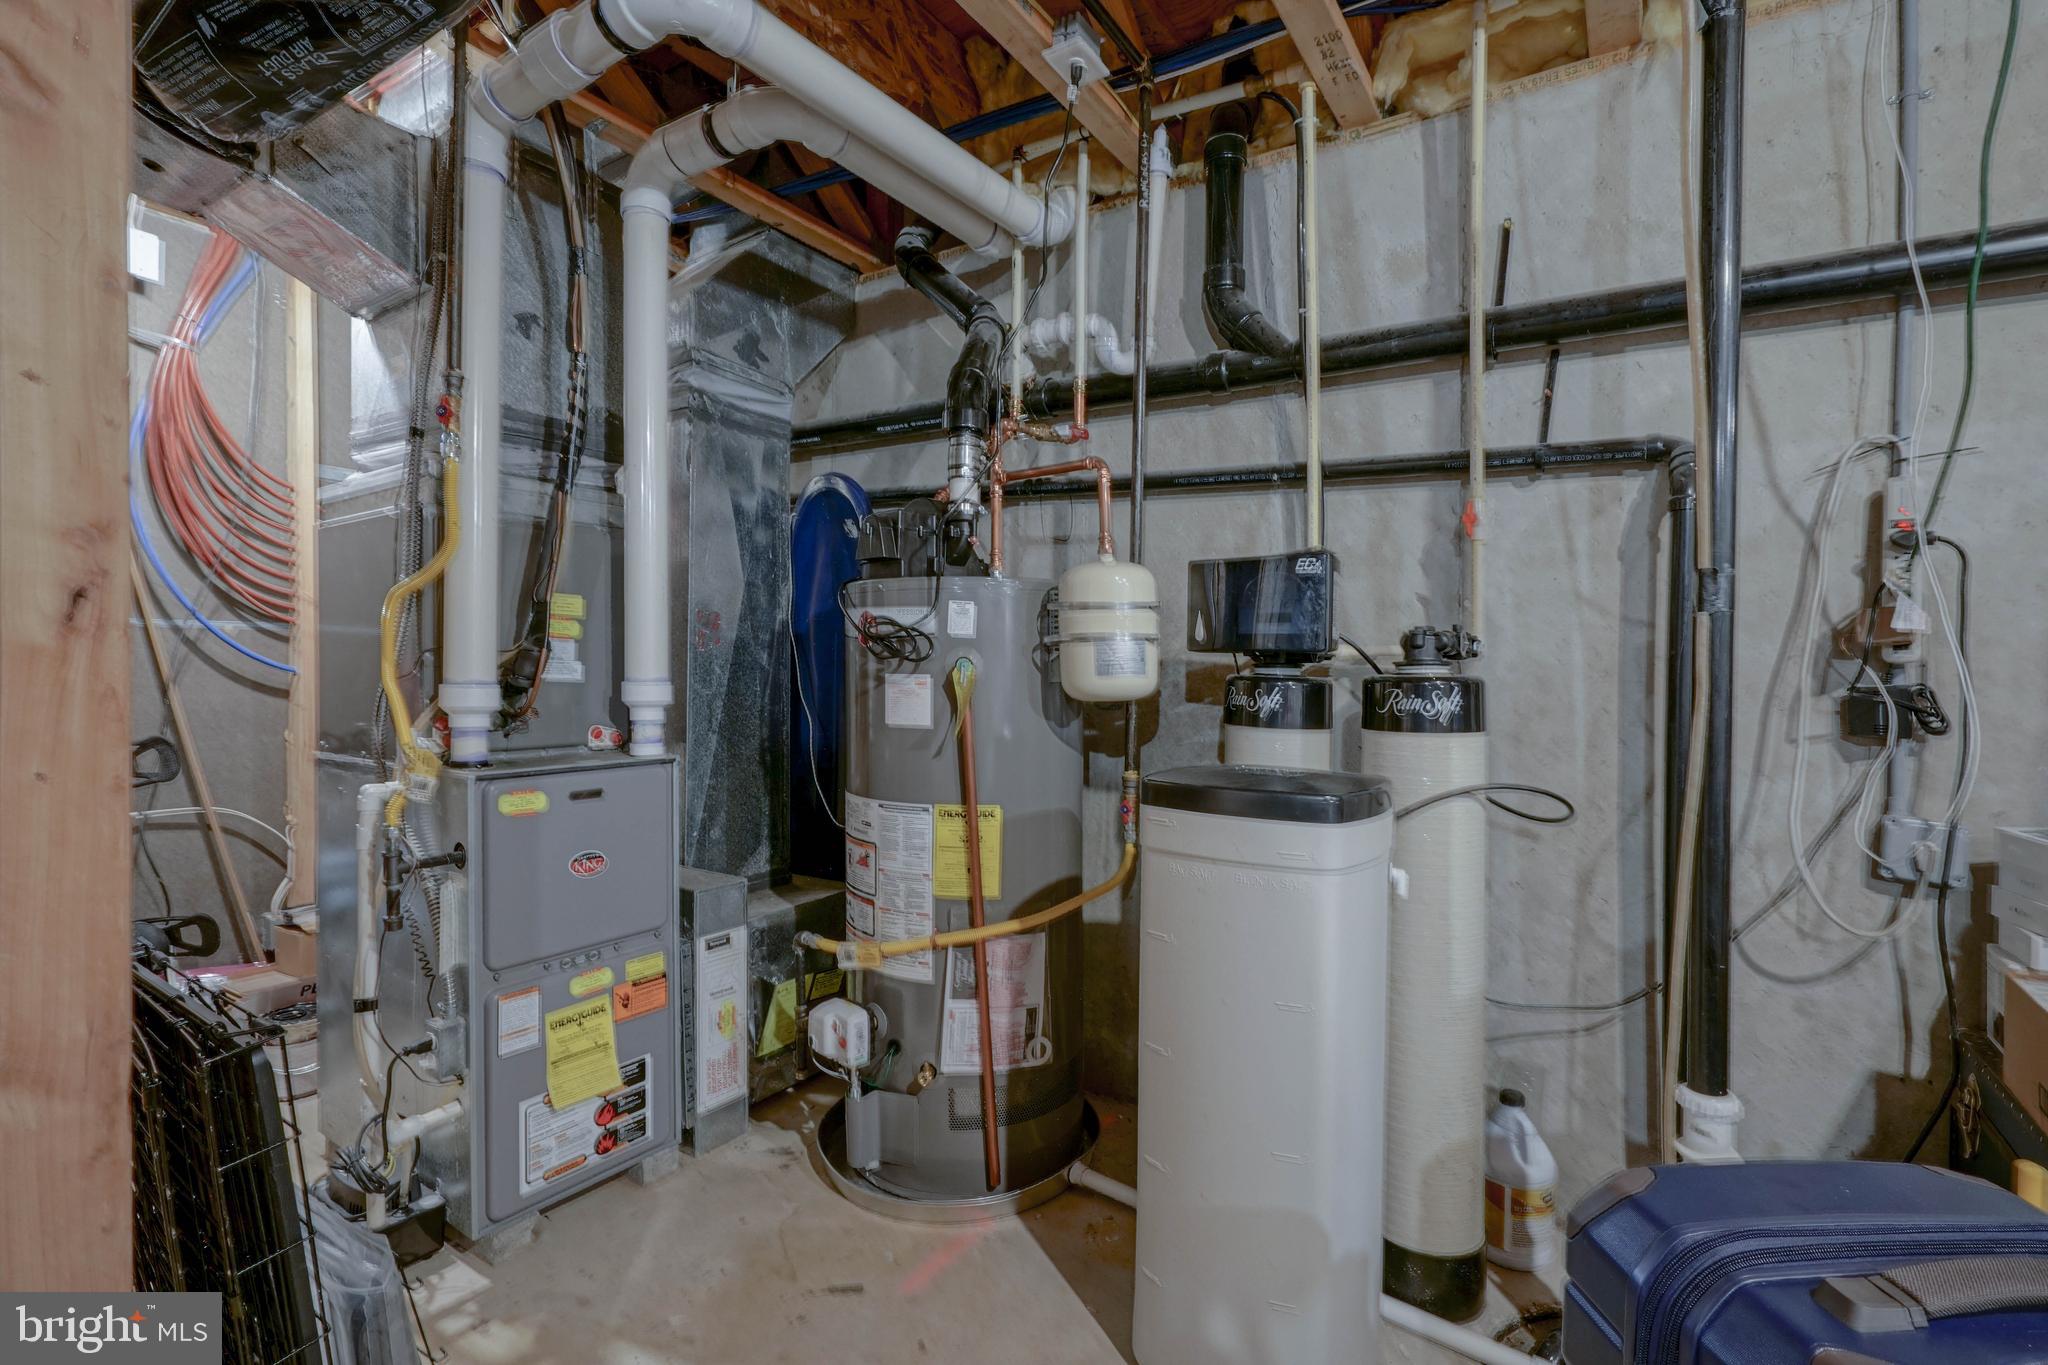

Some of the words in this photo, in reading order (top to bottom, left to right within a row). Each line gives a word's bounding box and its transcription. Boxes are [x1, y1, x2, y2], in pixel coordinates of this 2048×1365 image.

[291, 36, 316, 58] AIR
[257, 48, 294, 78] DUCT
[281, 49, 329, 81] CLASS
[1376, 686, 1465, 726] RainSoft
